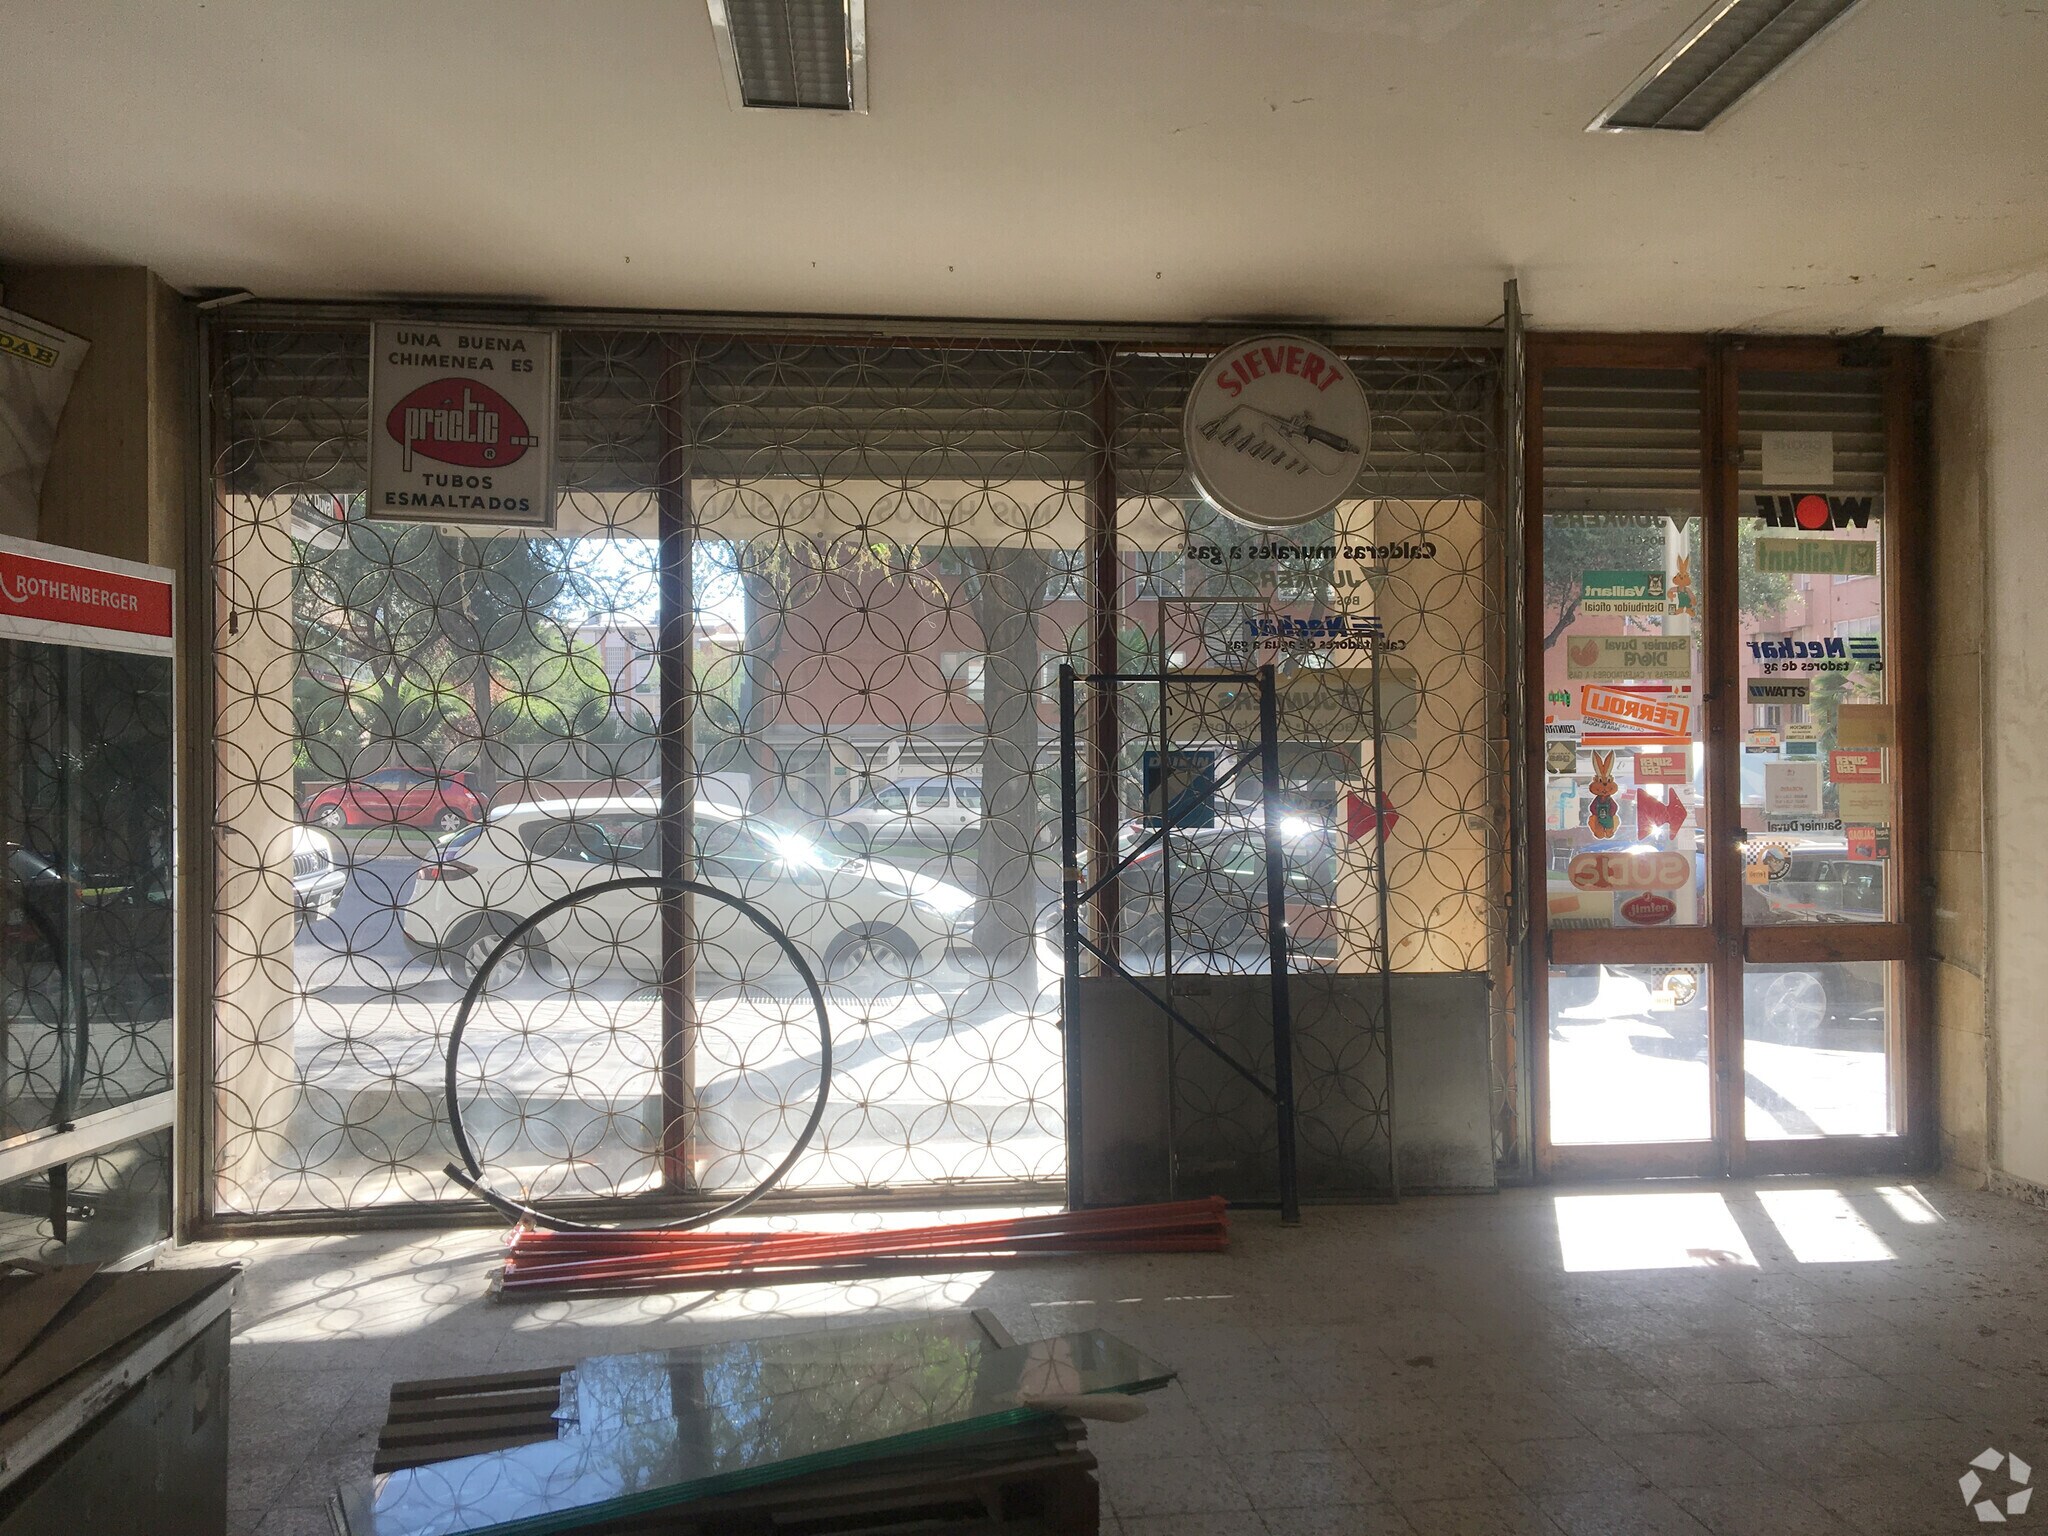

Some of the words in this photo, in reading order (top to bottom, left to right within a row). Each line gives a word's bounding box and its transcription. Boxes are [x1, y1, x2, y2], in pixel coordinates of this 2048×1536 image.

[0, 333, 53, 364] DAB
[396, 331, 441, 348] UNA
[458, 335, 527, 353] BUENA
[388, 352, 494, 371] CHIMENEA
[511, 359, 534, 373] ES
[1216, 344, 1344, 398] SIEVERT
[422, 473, 493, 490] TUBOS
[385, 491, 530, 512] ESMALTADOS
[16, 574, 138, 613] ROTHENBERGER
[1763, 686, 1807, 697] WATTS
